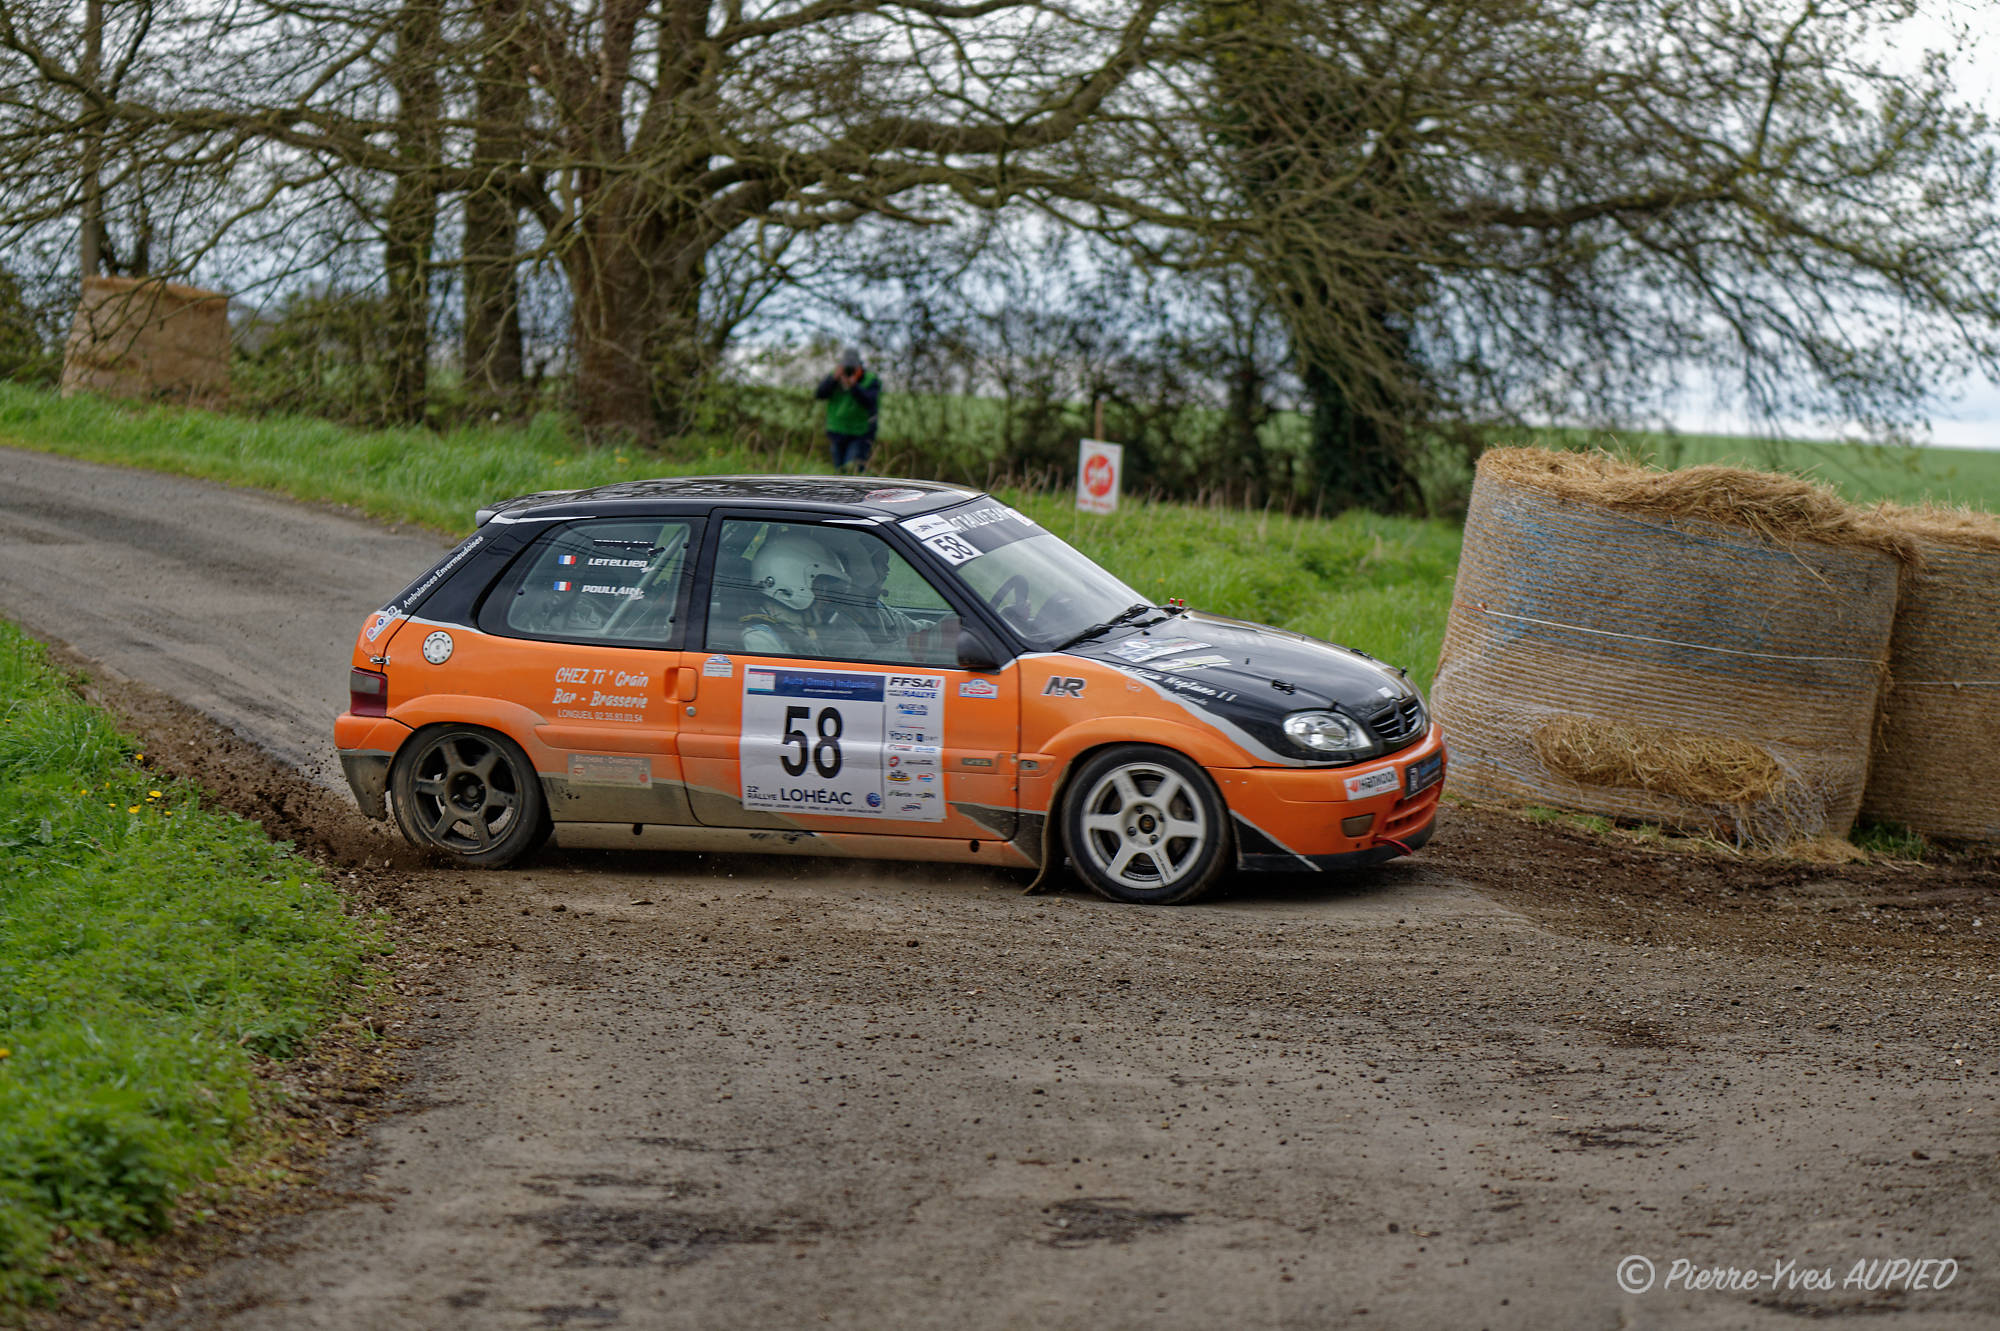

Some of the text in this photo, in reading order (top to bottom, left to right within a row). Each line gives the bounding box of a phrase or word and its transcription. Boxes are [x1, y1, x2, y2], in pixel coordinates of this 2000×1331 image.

[932, 535, 974, 560] 58
[555, 667, 589, 684] CHEZ
[889, 676, 935, 689] FFSA
[552, 688, 576, 704] Bar
[589, 690, 648, 709] Brasserie
[779, 705, 843, 779] 58
[747, 787, 853, 805] RALLYE LOHÉAC
